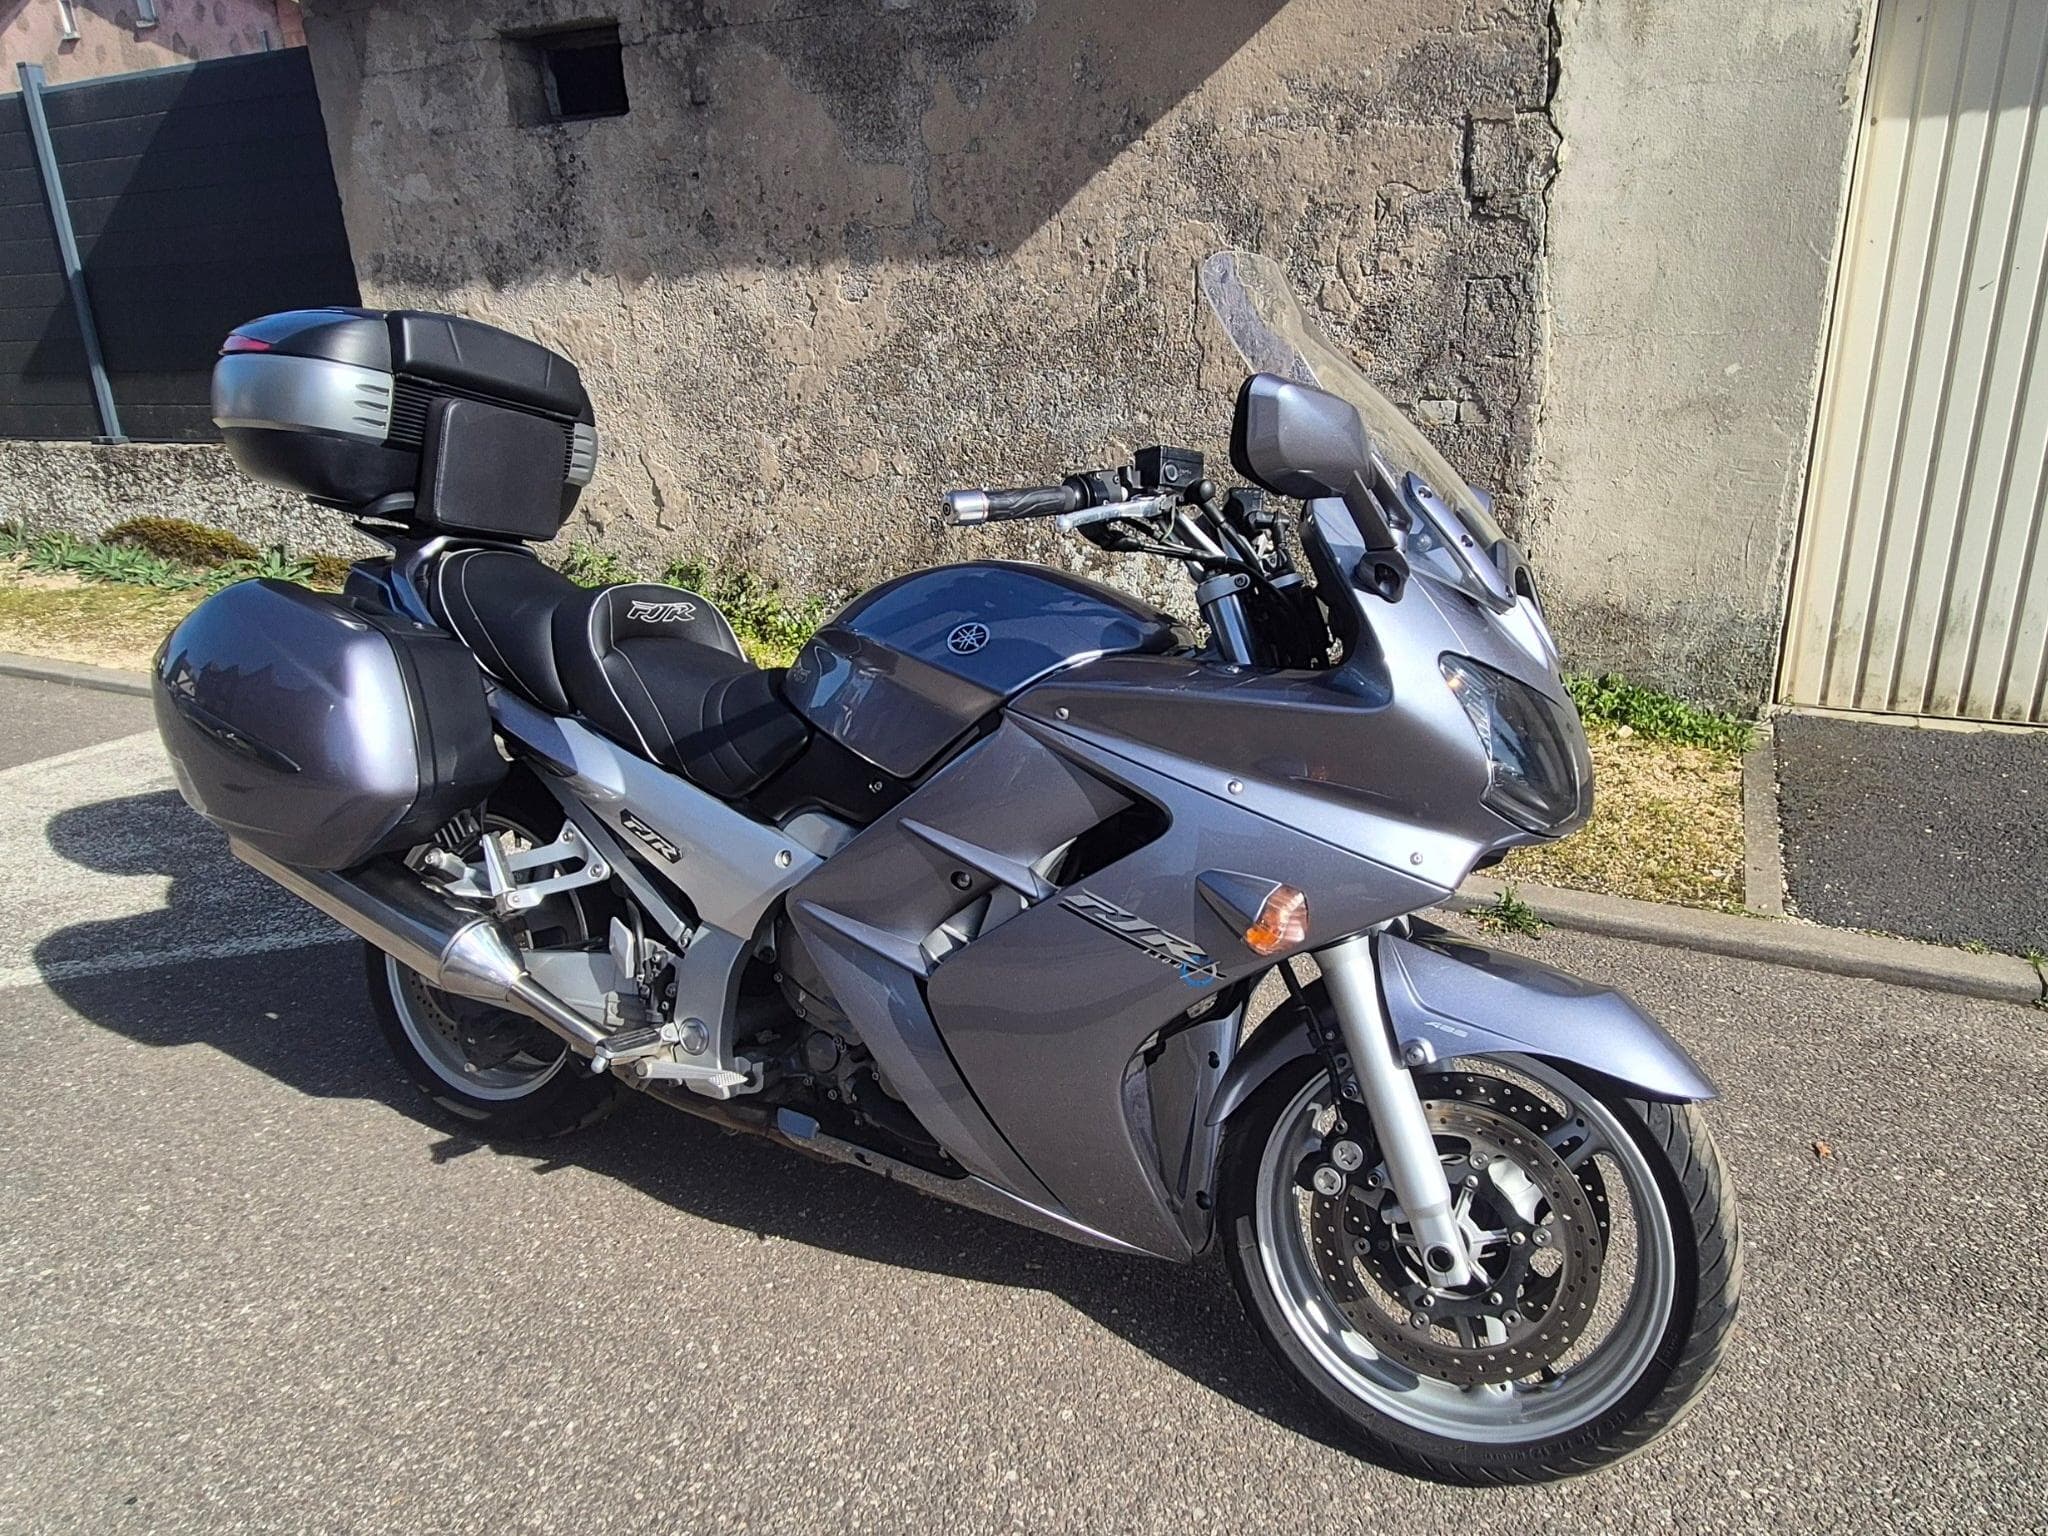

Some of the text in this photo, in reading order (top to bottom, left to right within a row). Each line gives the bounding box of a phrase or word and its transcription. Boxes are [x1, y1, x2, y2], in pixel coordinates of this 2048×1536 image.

[627, 600, 696, 622] FJR
[623, 815, 678, 860] FJR
[1064, 887, 1207, 965] FJR
